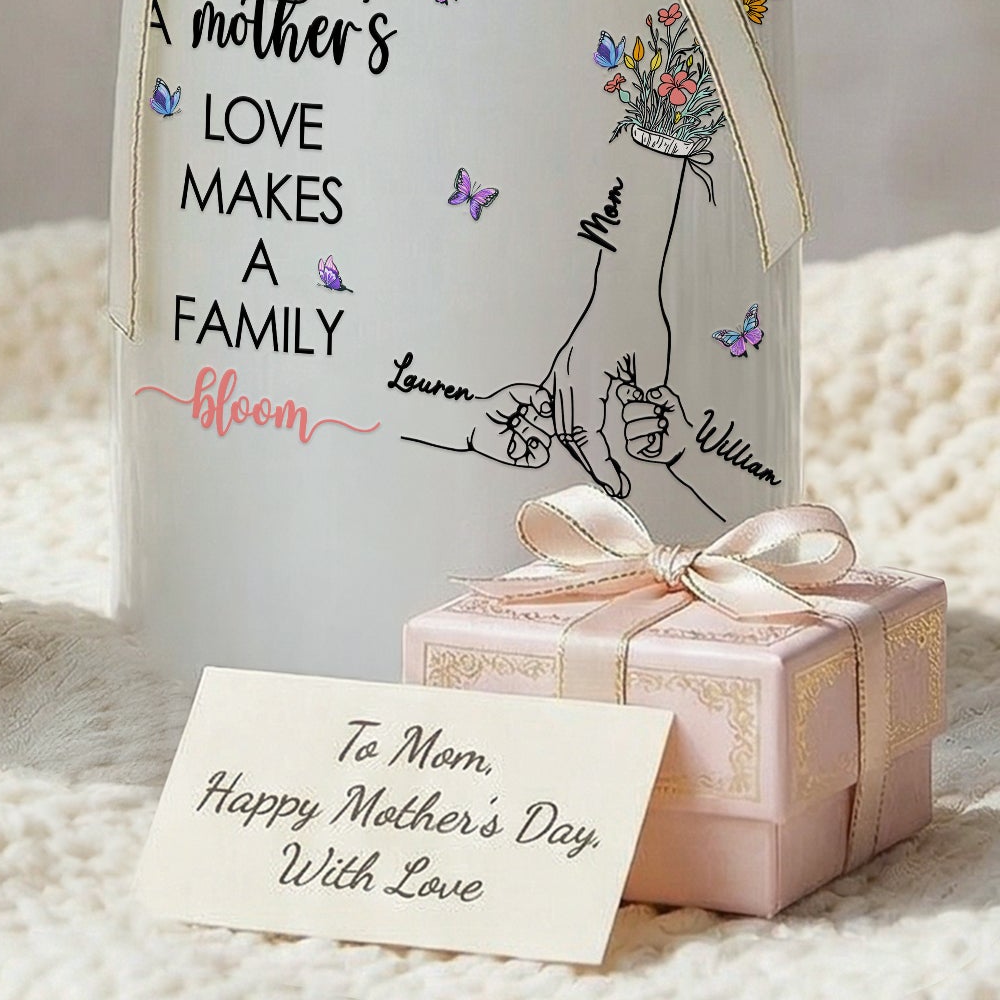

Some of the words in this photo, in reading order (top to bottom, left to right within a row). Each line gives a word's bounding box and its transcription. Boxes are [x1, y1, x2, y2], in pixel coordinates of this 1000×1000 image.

[204, 93, 323, 151] LOVE
[180, 163, 343, 226] MAKES
[577, 176, 624, 253] Mom
[241, 238, 279, 286] A
[173, 295, 345, 356] FAMILY
[134, 366, 381, 444] bloom
[387, 352, 475, 401] Lauren
[695, 409, 782, 487] William
[336, 720, 382, 763] To
[196, 770, 321, 829] Happy
[329, 784, 505, 839] Mother's
[278, 843, 375, 893] With
[384, 857, 485, 904] Love
